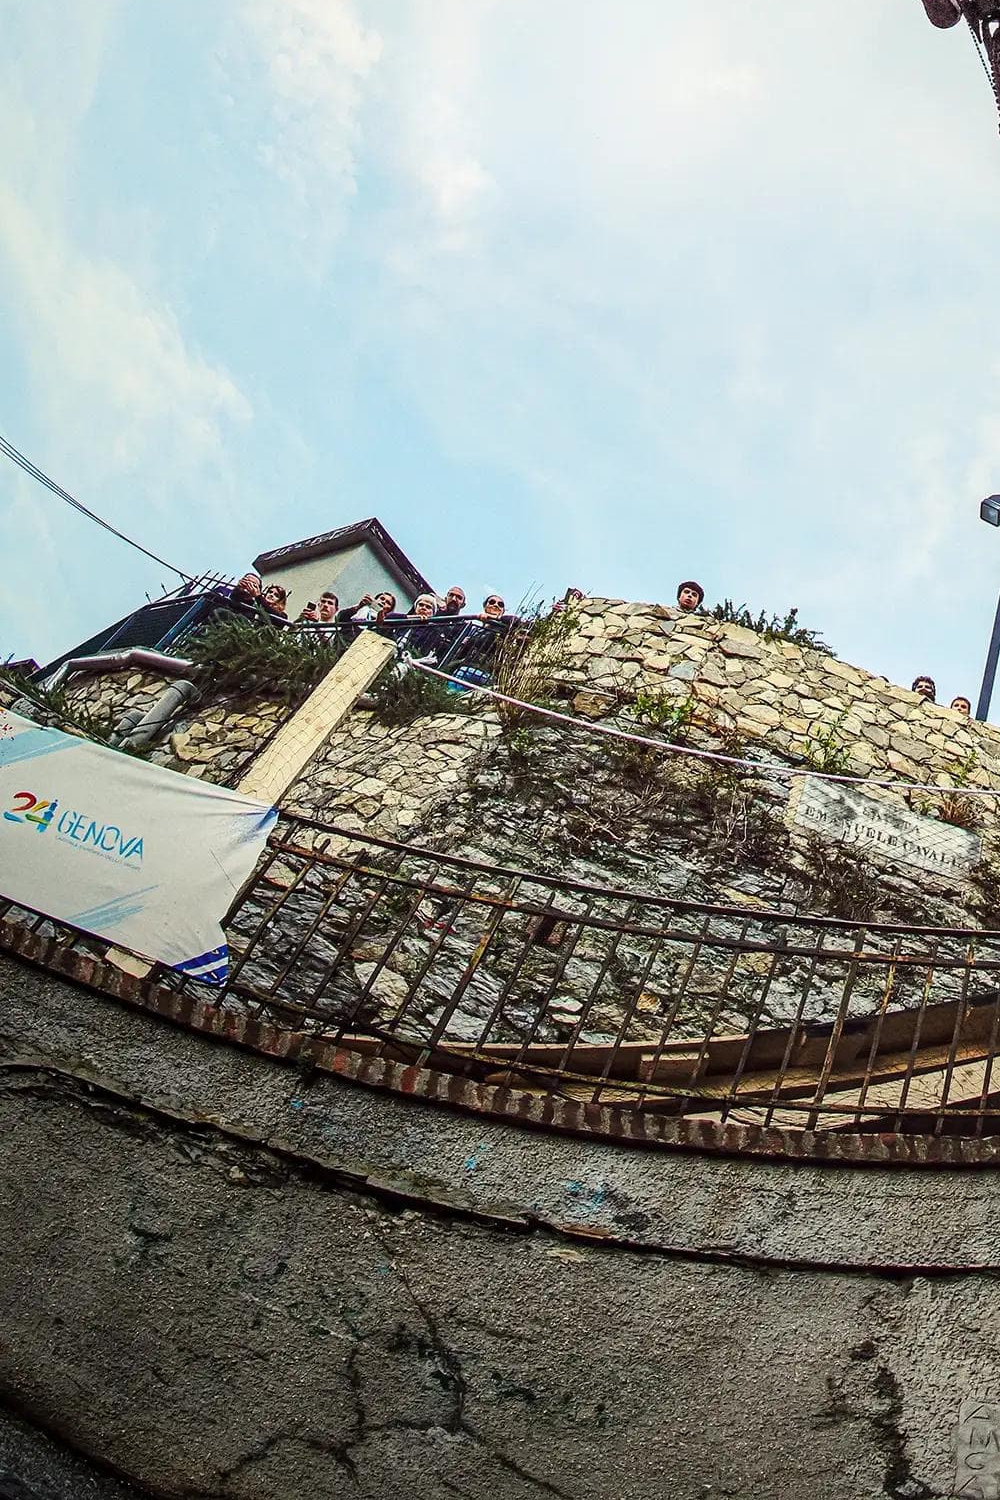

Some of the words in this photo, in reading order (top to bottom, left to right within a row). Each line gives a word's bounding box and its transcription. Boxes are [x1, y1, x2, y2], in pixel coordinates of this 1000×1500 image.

[3, 791, 59, 833] 24
[57, 810, 144, 861] GENOVA
[862, 807, 921, 834] SATA
